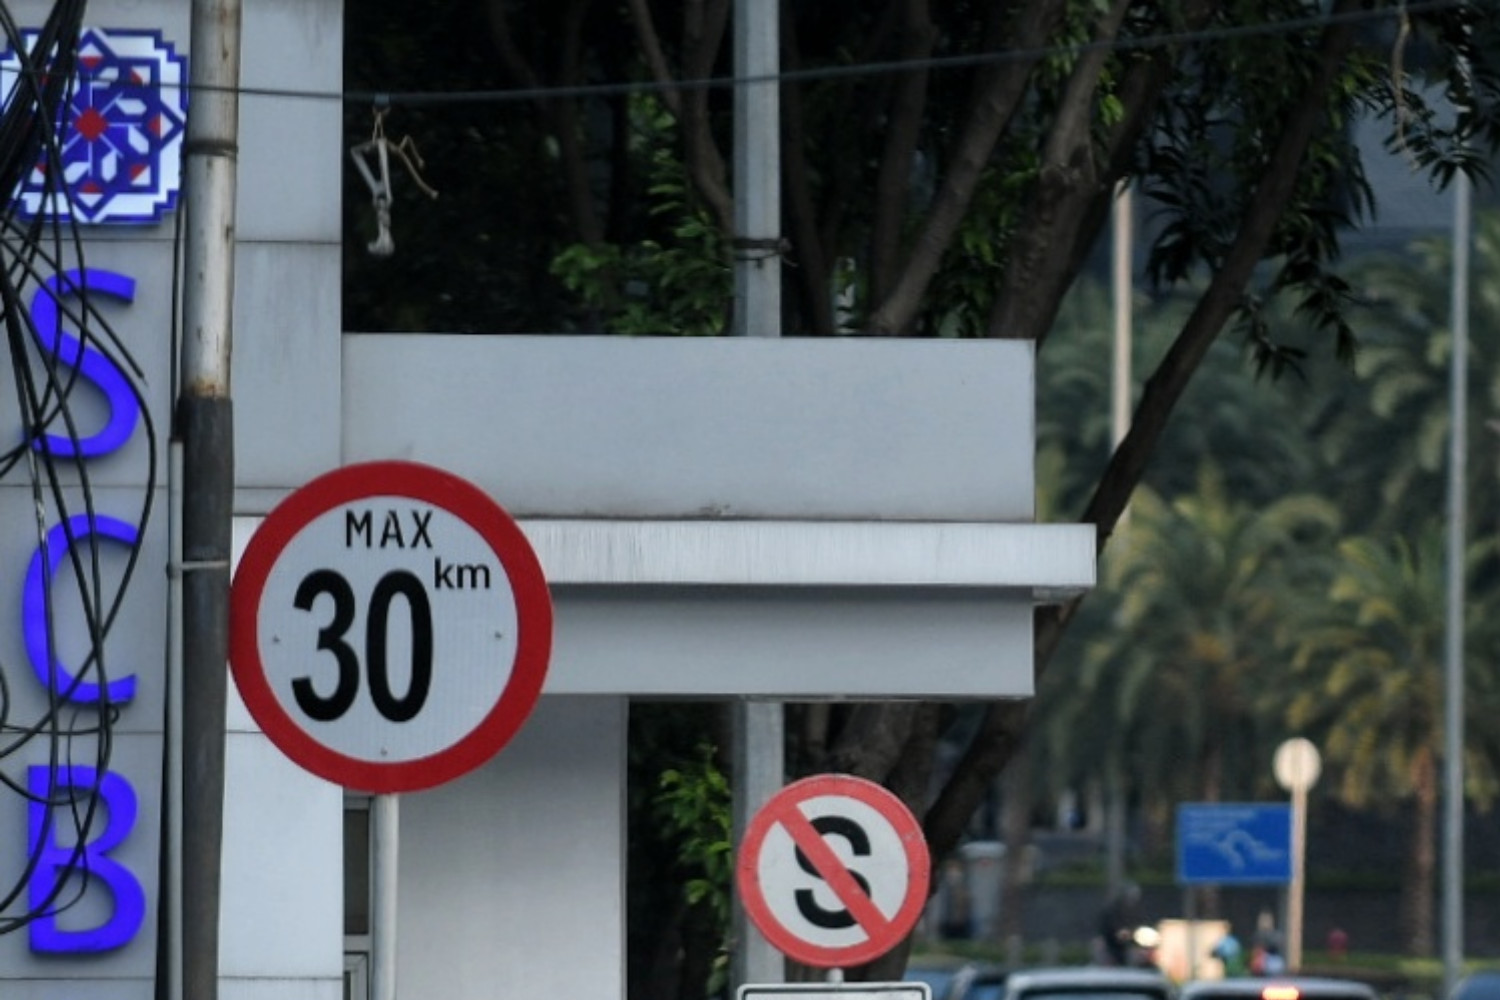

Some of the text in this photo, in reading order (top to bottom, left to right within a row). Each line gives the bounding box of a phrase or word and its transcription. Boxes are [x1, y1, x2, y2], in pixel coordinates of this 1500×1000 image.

[345, 509, 434, 548] MAX
[291, 556, 491, 723] 30 km
[794, 815, 872, 930] S
